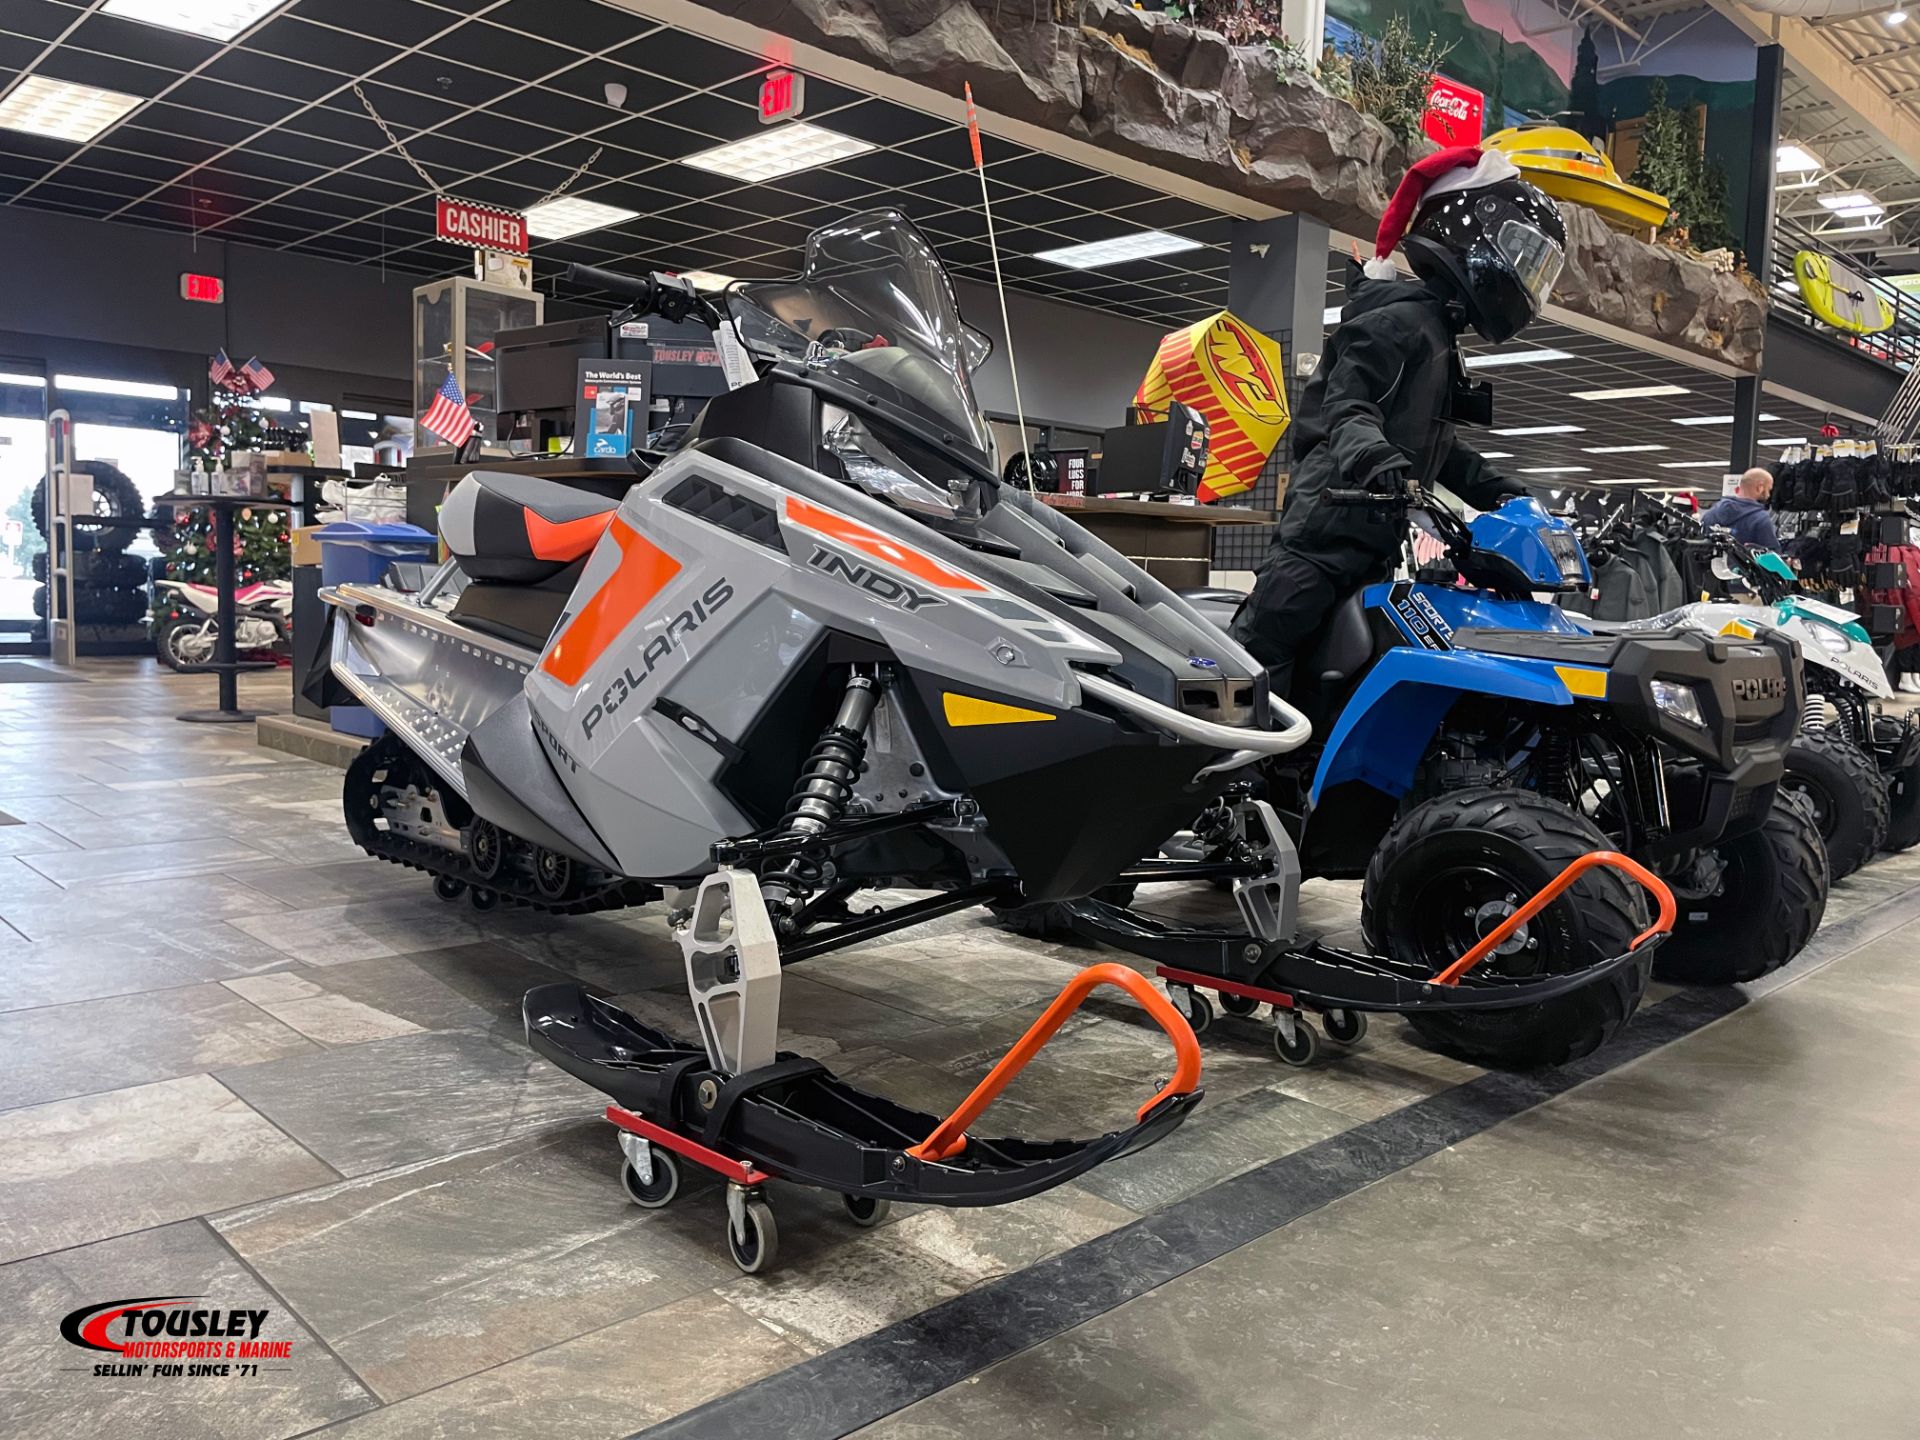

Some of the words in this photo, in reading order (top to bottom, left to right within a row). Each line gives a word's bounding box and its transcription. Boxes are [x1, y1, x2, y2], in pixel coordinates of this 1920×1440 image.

[446, 207, 520, 246] CASHIER
[654, 349, 693, 362] TOUSLEY
[585, 371, 598, 379] The
[599, 371, 624, 379] World's
[625, 372, 641, 381] Best
[1068, 458, 1084, 469] FOUR
[1068, 469, 1084, 480] LUGS
[1071, 480, 1084, 490] FOR
[807, 545, 947, 613] INDY
[1397, 599, 1430, 635] 110
[580, 576, 735, 741] POLARIS
[1830, 656, 1879, 690] POLARIS
[533, 708, 582, 775] SPORT
